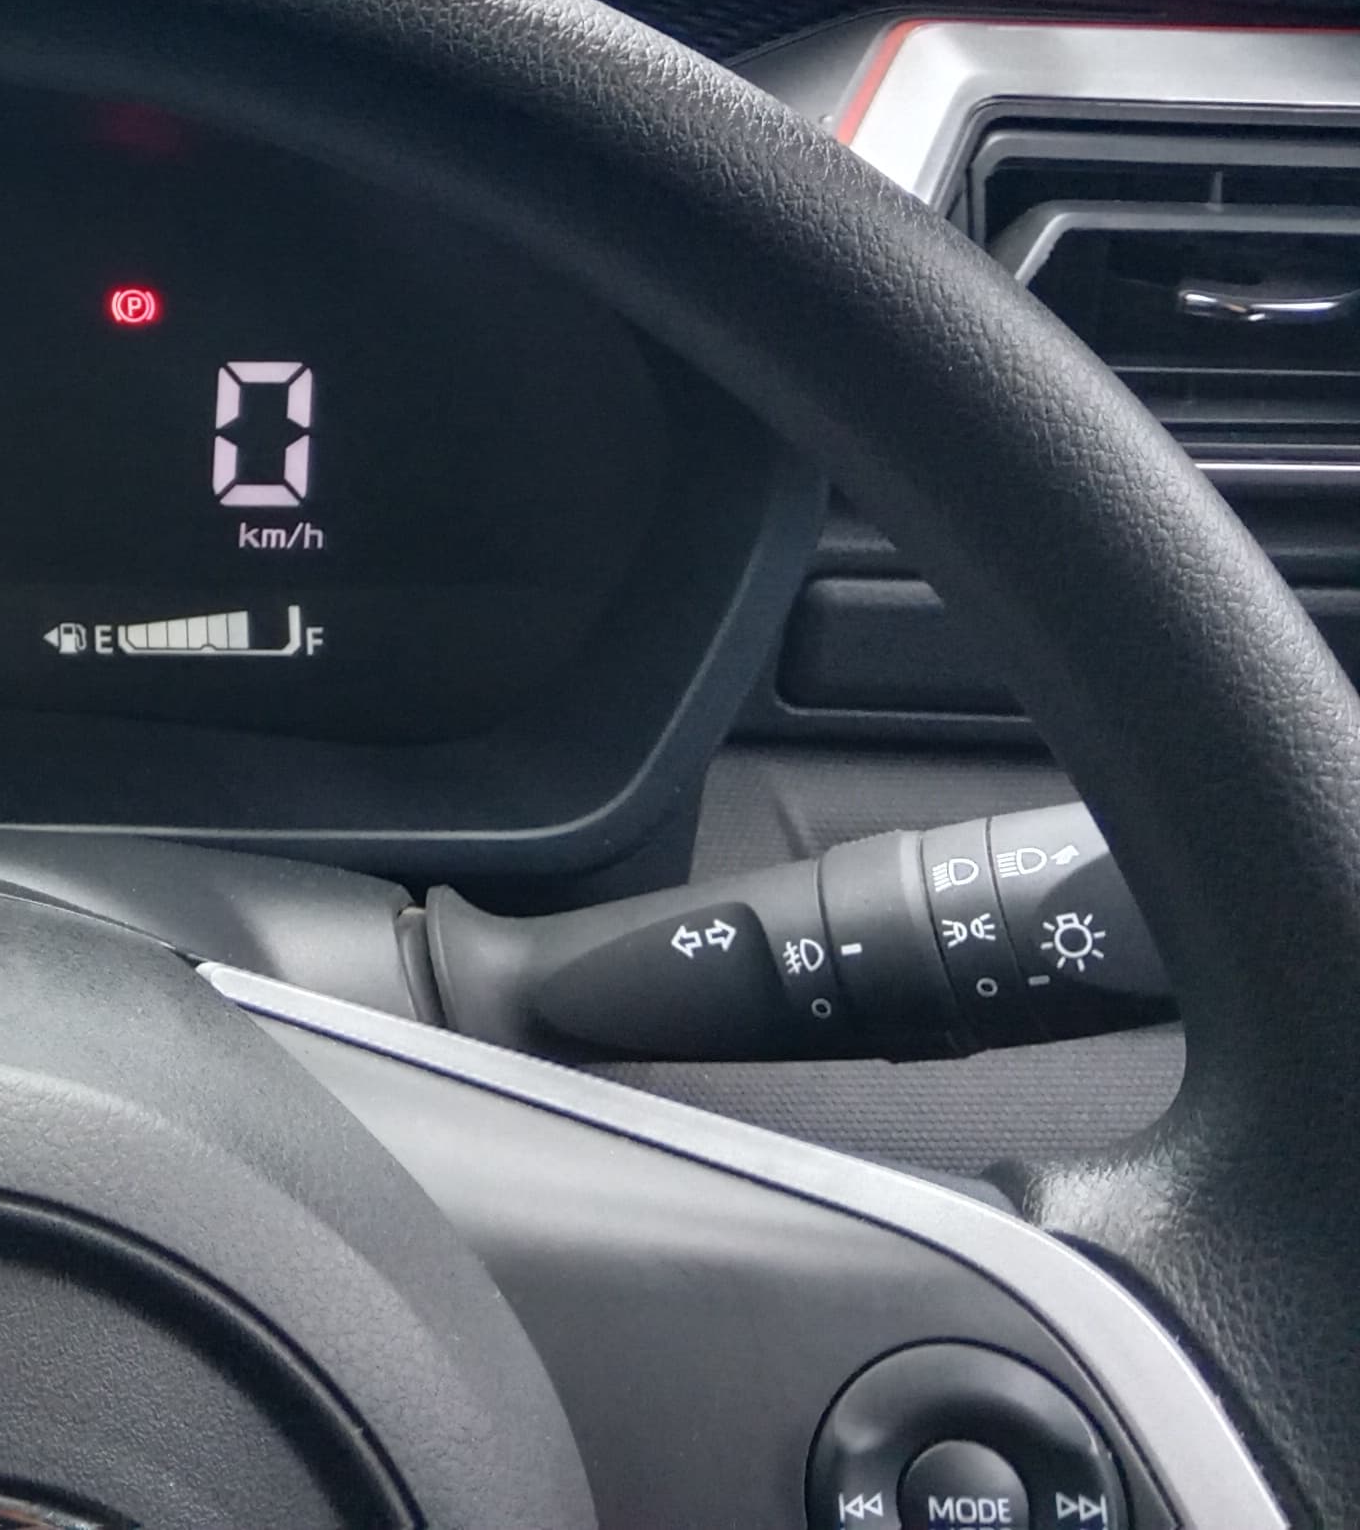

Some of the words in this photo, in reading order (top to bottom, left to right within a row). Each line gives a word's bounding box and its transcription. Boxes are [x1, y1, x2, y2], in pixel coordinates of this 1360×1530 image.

[212, 360, 314, 508] 0
[239, 522, 324, 550] km/h
[94, 625, 112, 655] E
[307, 627, 324, 656] F
[927, 1494, 1012, 1524] MODE
